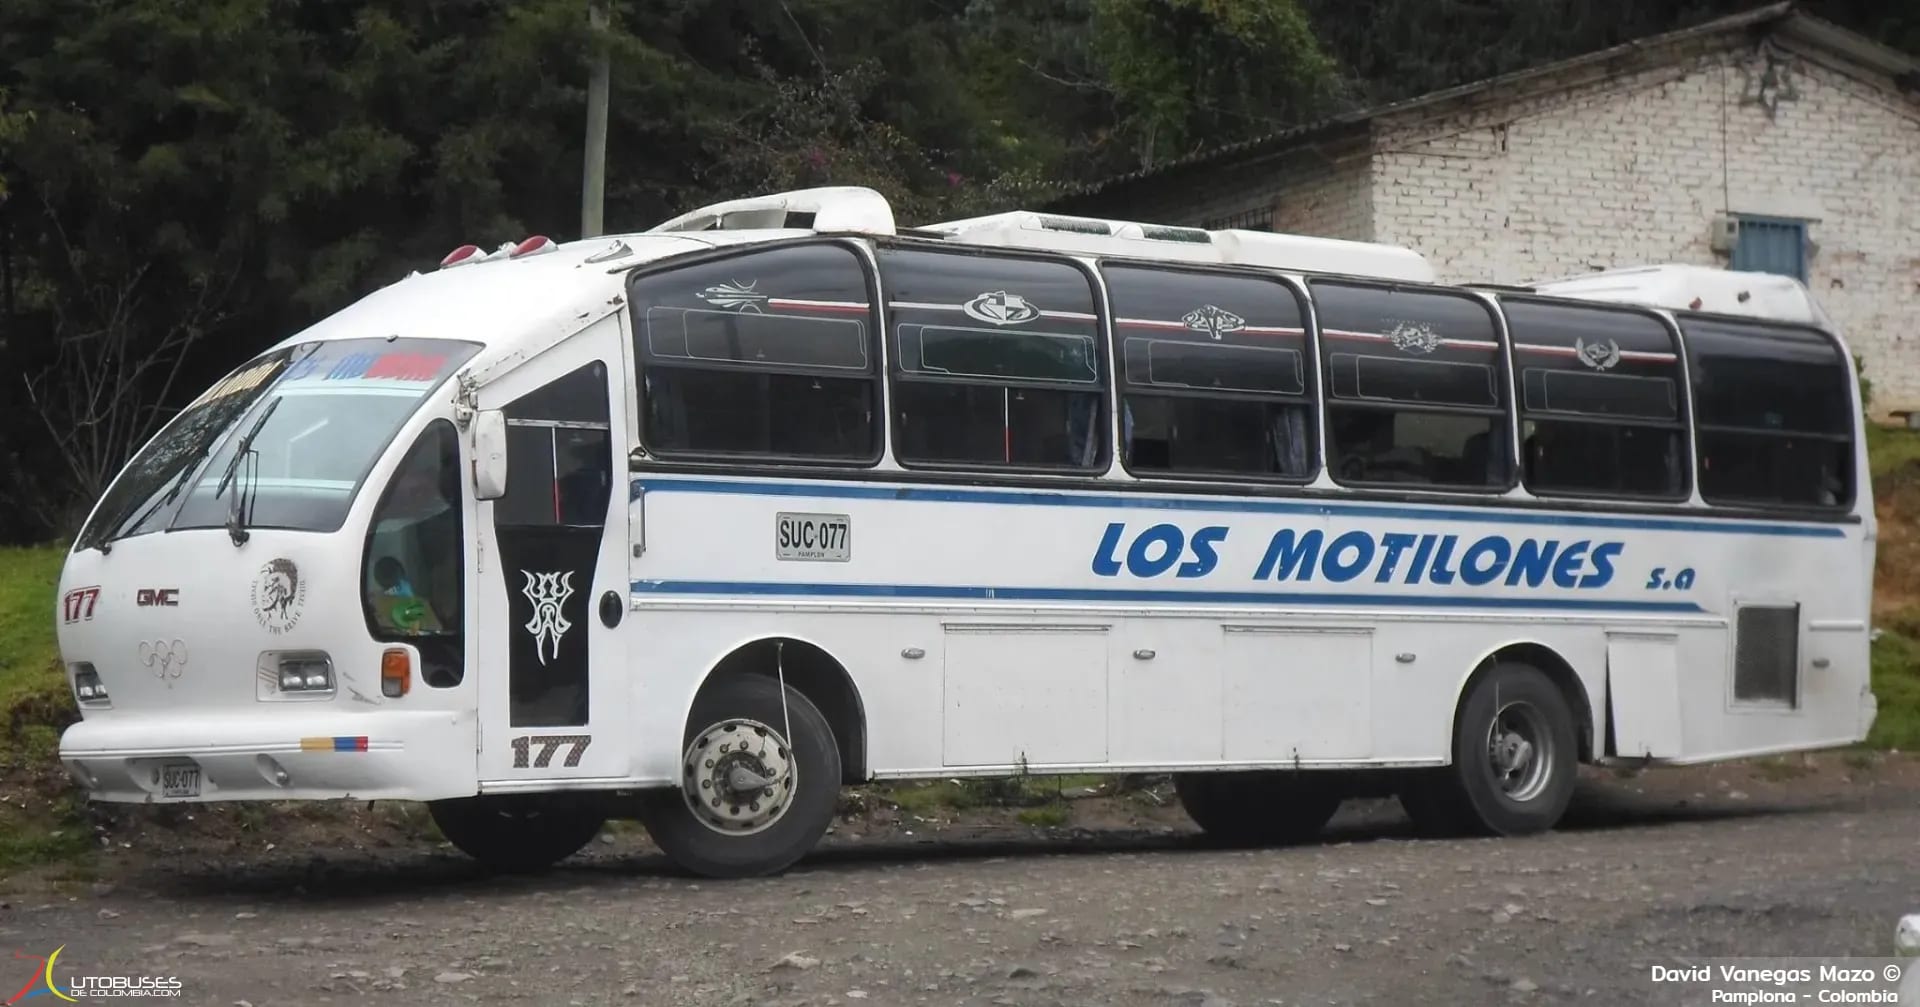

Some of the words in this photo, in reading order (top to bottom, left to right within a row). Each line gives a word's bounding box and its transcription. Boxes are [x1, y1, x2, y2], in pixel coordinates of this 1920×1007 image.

[1091, 522, 1230, 579] LOS
[1252, 528, 1625, 588] MOTILONES
[64, 584, 102, 625] 177
[136, 588, 180, 607] GMC
[511, 734, 592, 769] 177
